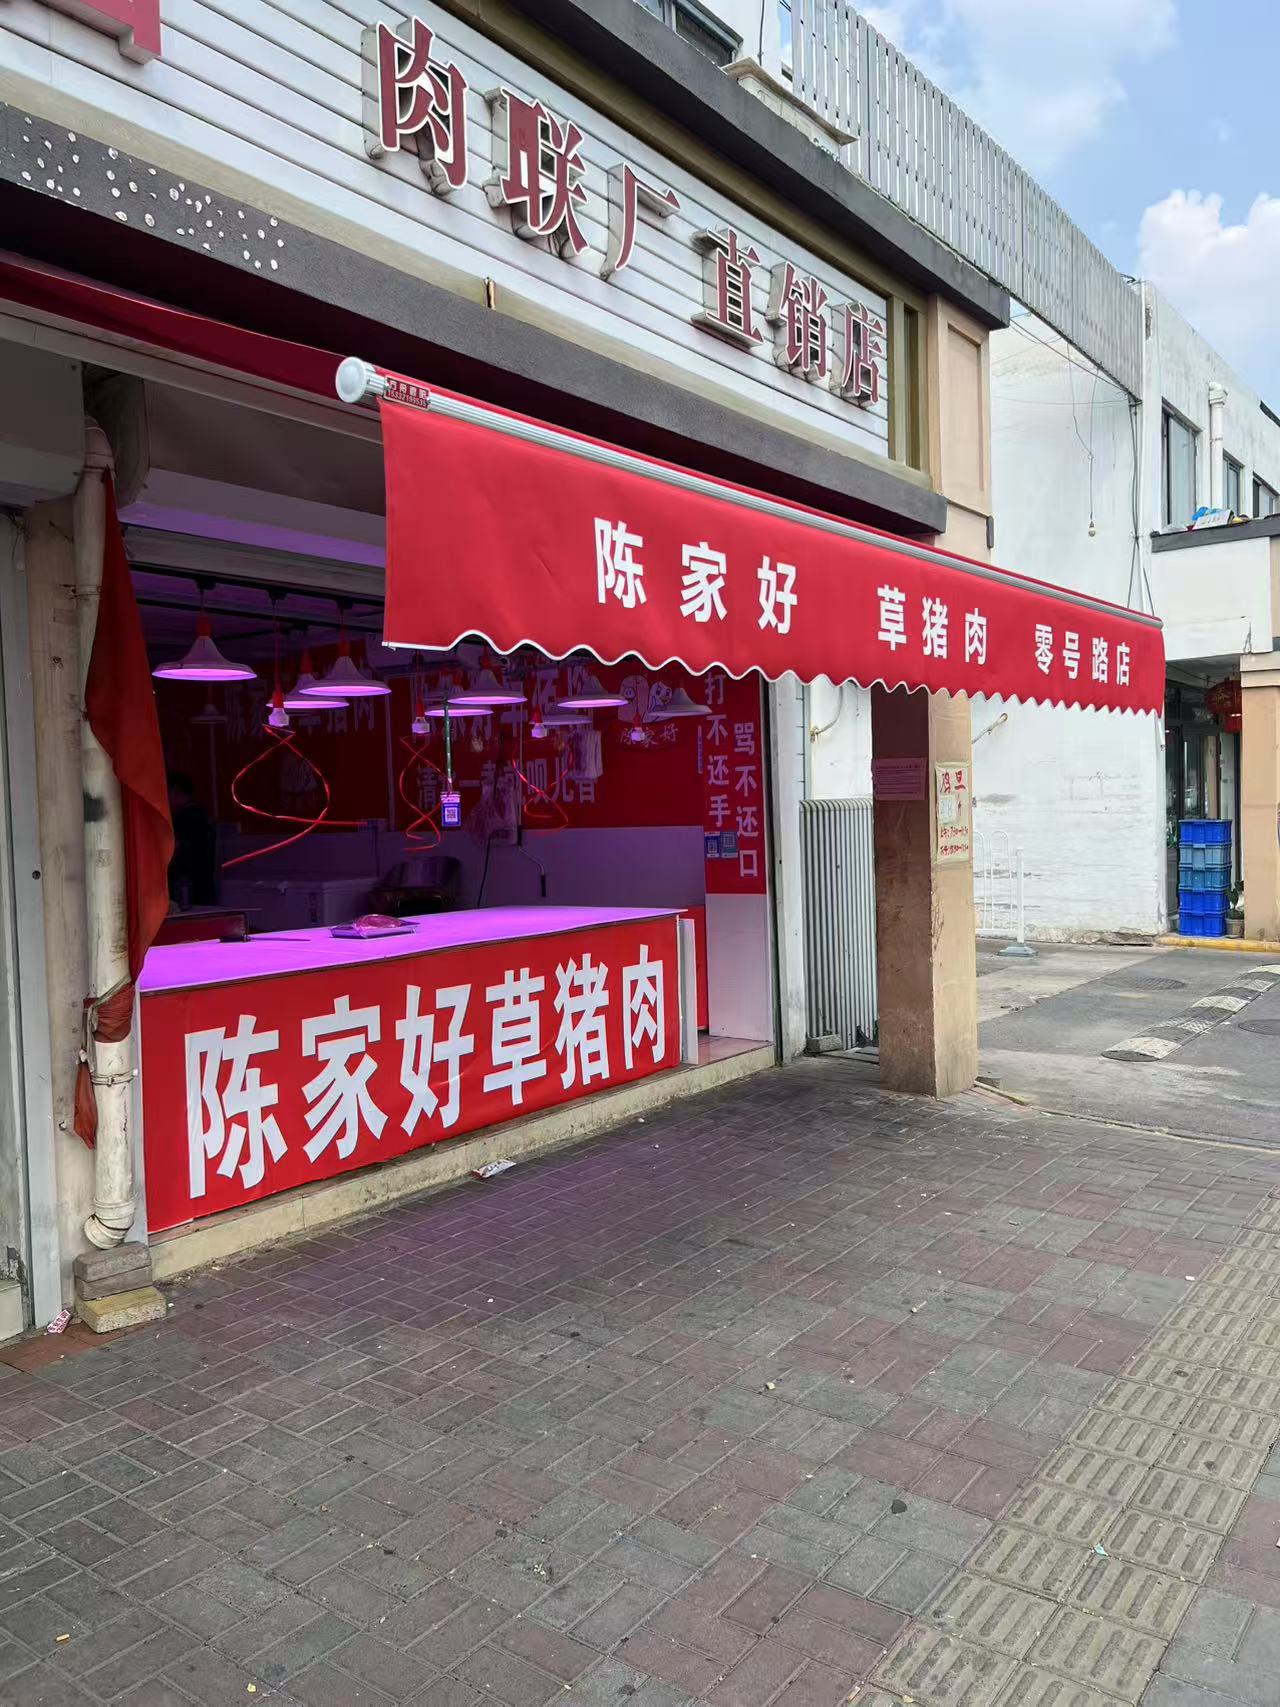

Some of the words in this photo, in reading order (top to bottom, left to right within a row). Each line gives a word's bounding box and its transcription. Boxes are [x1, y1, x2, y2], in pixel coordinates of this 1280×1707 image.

[593, 516, 799, 635] 陈家好
[876, 585, 989, 665] 草猪肉
[1033, 623, 1131, 686] 零号路店
[704, 672, 732, 828] 打不还手
[734, 721, 759, 877] 骂不还口
[184, 944, 669, 1199] 陈家好草猪肉
